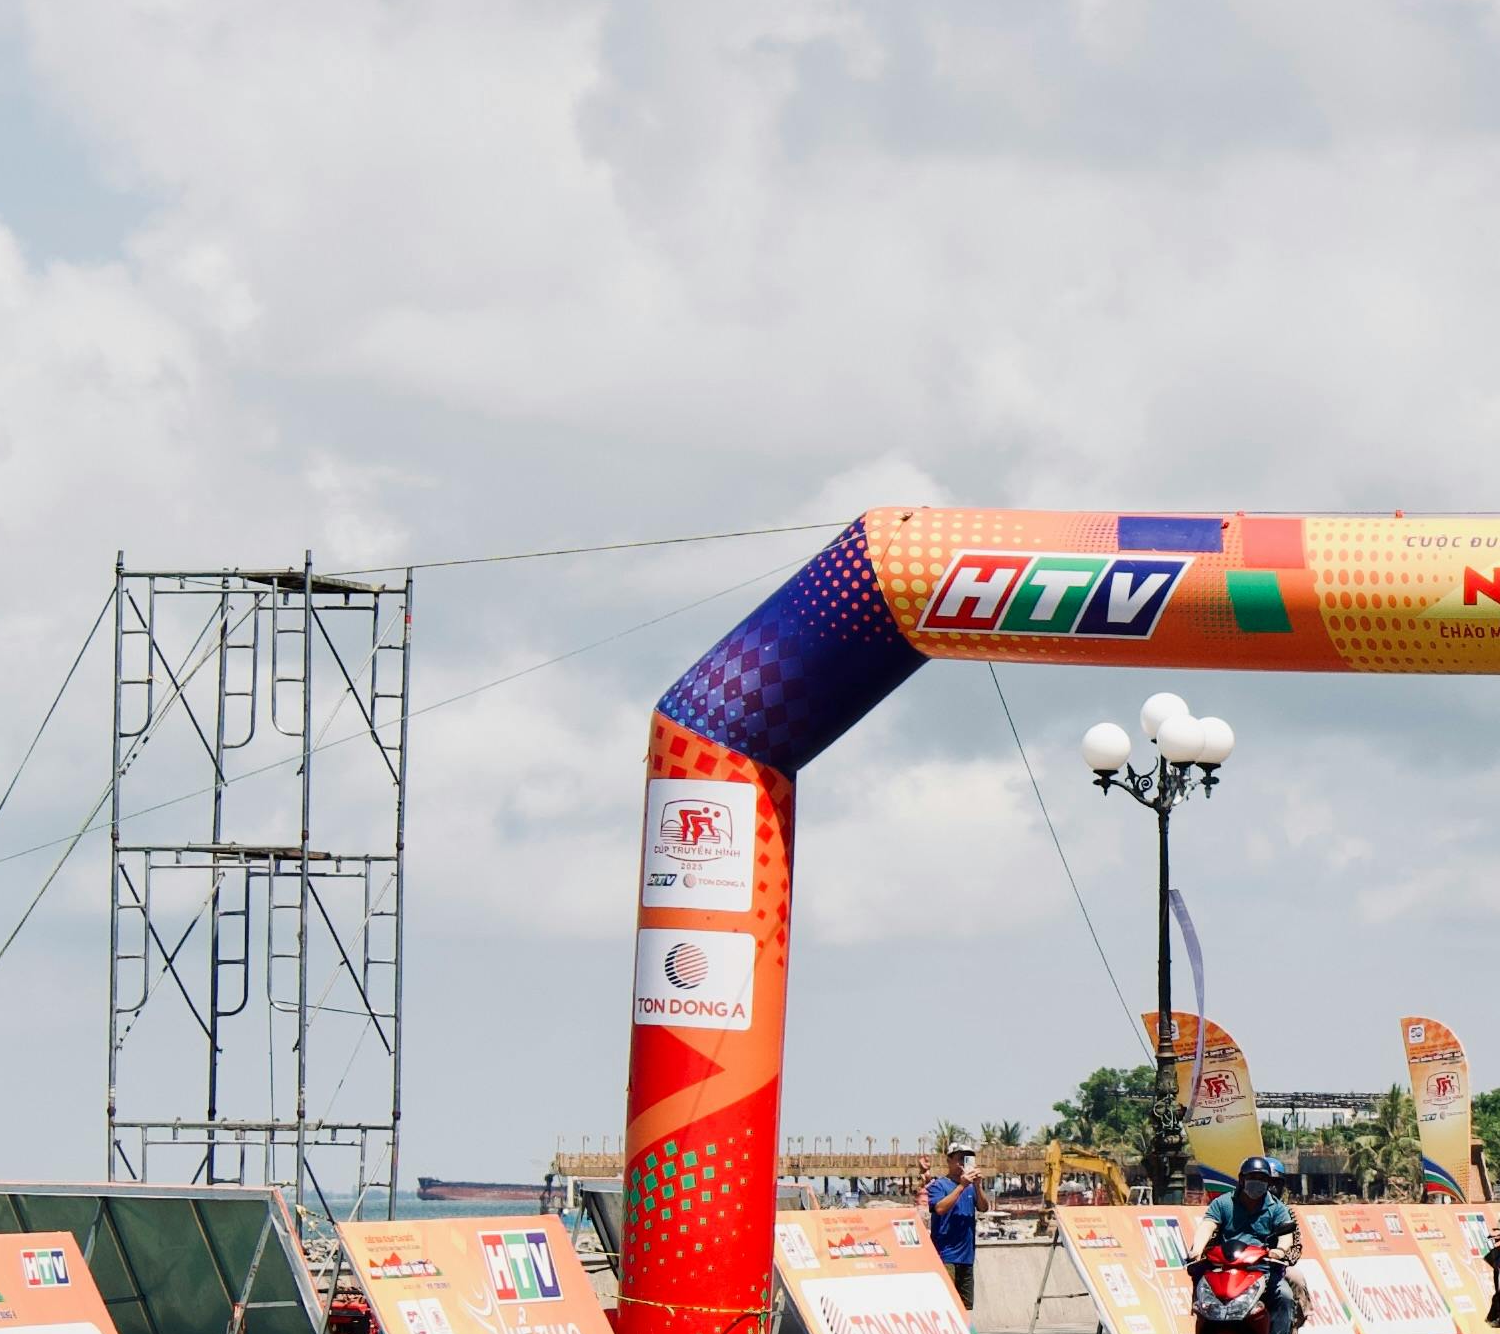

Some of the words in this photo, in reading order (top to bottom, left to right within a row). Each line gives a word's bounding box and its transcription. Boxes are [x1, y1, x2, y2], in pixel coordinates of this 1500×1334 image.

[1406, 536, 1462, 549] CUỘC
[938, 565, 1175, 626] HTV
[1440, 624, 1485, 639] CHÀO
